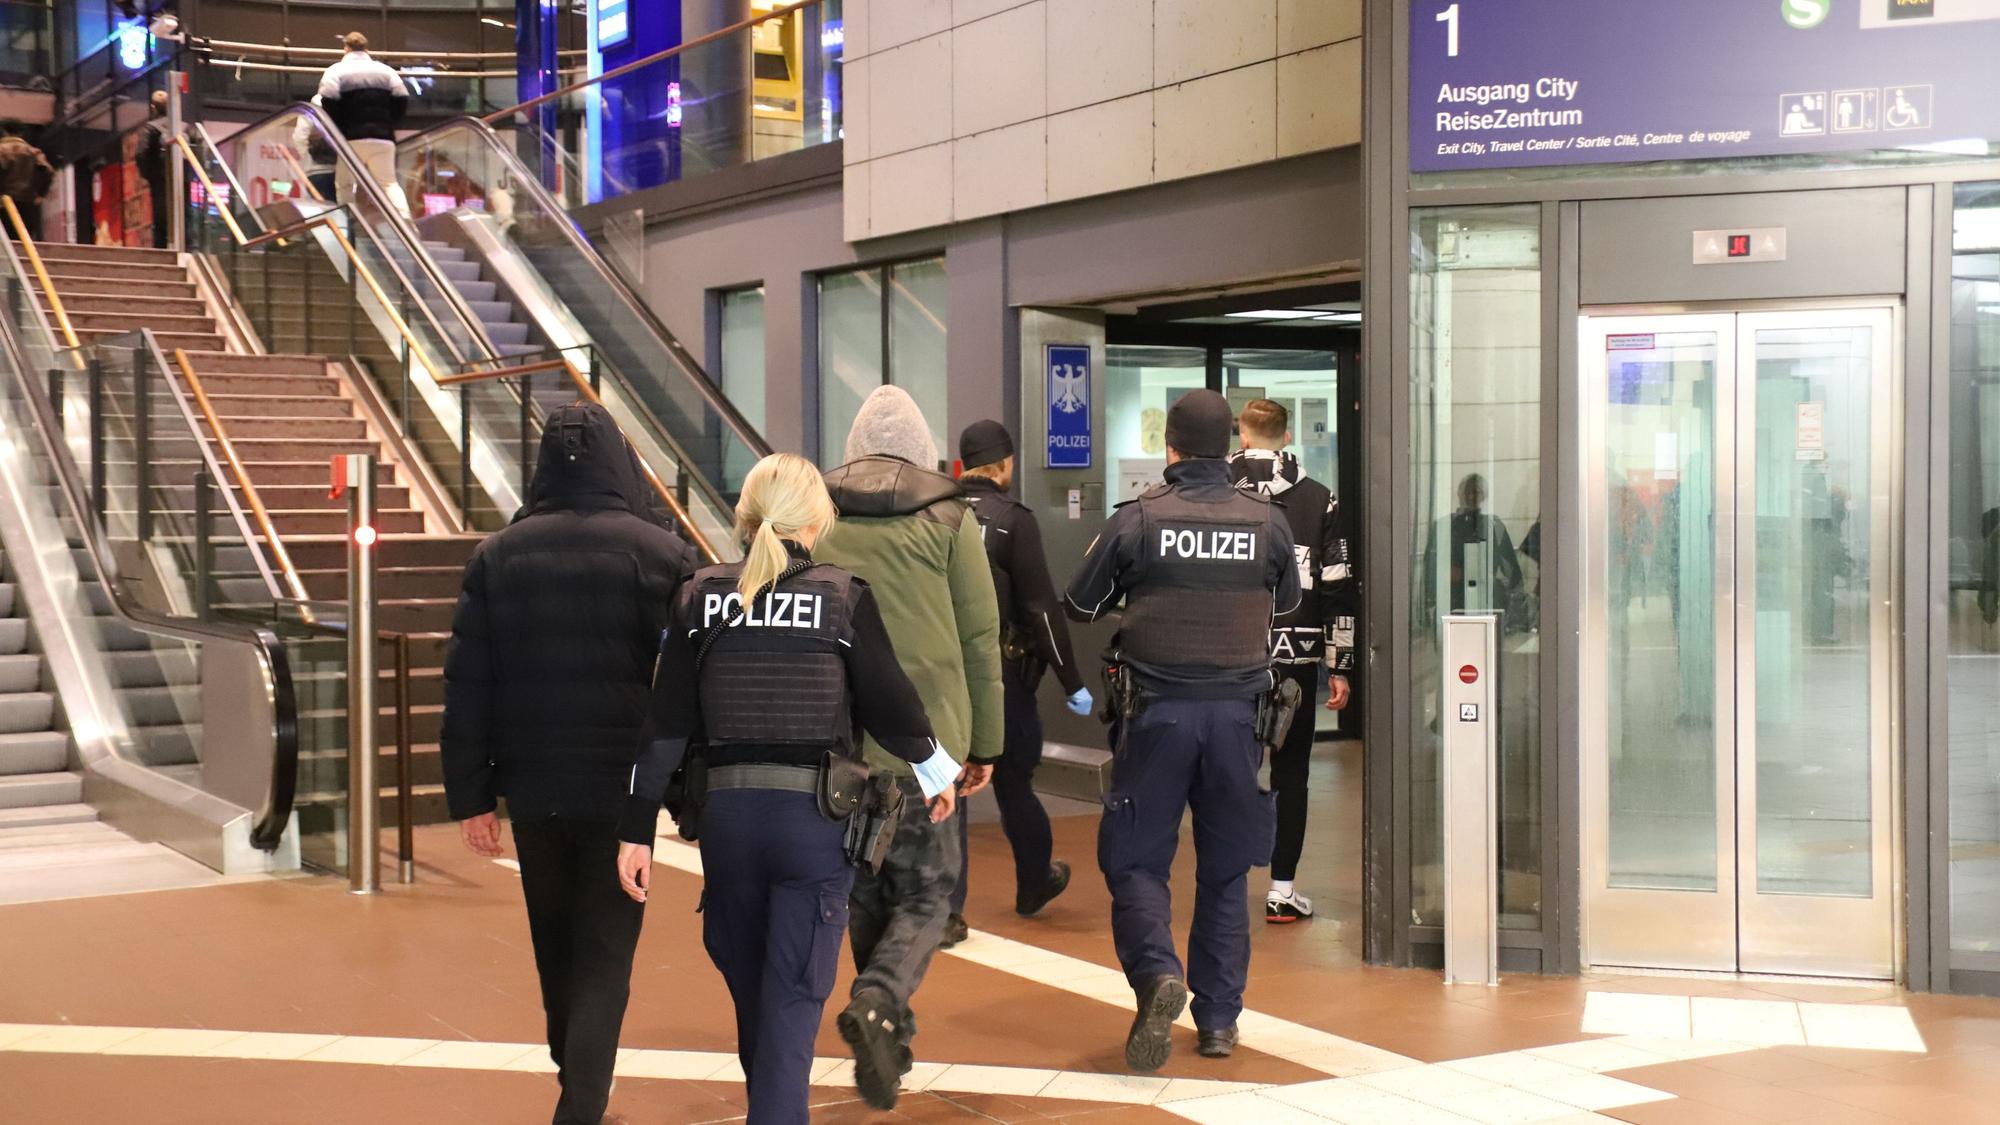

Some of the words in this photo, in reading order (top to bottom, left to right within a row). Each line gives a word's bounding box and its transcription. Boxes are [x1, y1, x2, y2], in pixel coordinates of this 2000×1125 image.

[1436, 4, 1459, 56] 1
[1437, 83, 1530, 105] Ausgang
[1536, 78, 1578, 100] City
[1436, 108, 1583, 131] ReiseZentrum
[1437, 143, 1459, 155] Exit
[1461, 142, 1486, 155] City,
[1490, 140, 1524, 152] Travel
[1526, 139, 1565, 150] Center
[1566, 137, 1574, 149] /
[1576, 135, 1610, 148] Sortie
[1613, 134, 1640, 147] Cité,
[1643, 132, 1683, 145] Centre
[1688, 130, 1704, 142] de
[1708, 130, 1751, 143] voyage
[1049, 435, 1090, 447] POLIZEI
[1160, 529, 1256, 560] POLIZEI
[704, 591, 822, 629] POLIZEI
